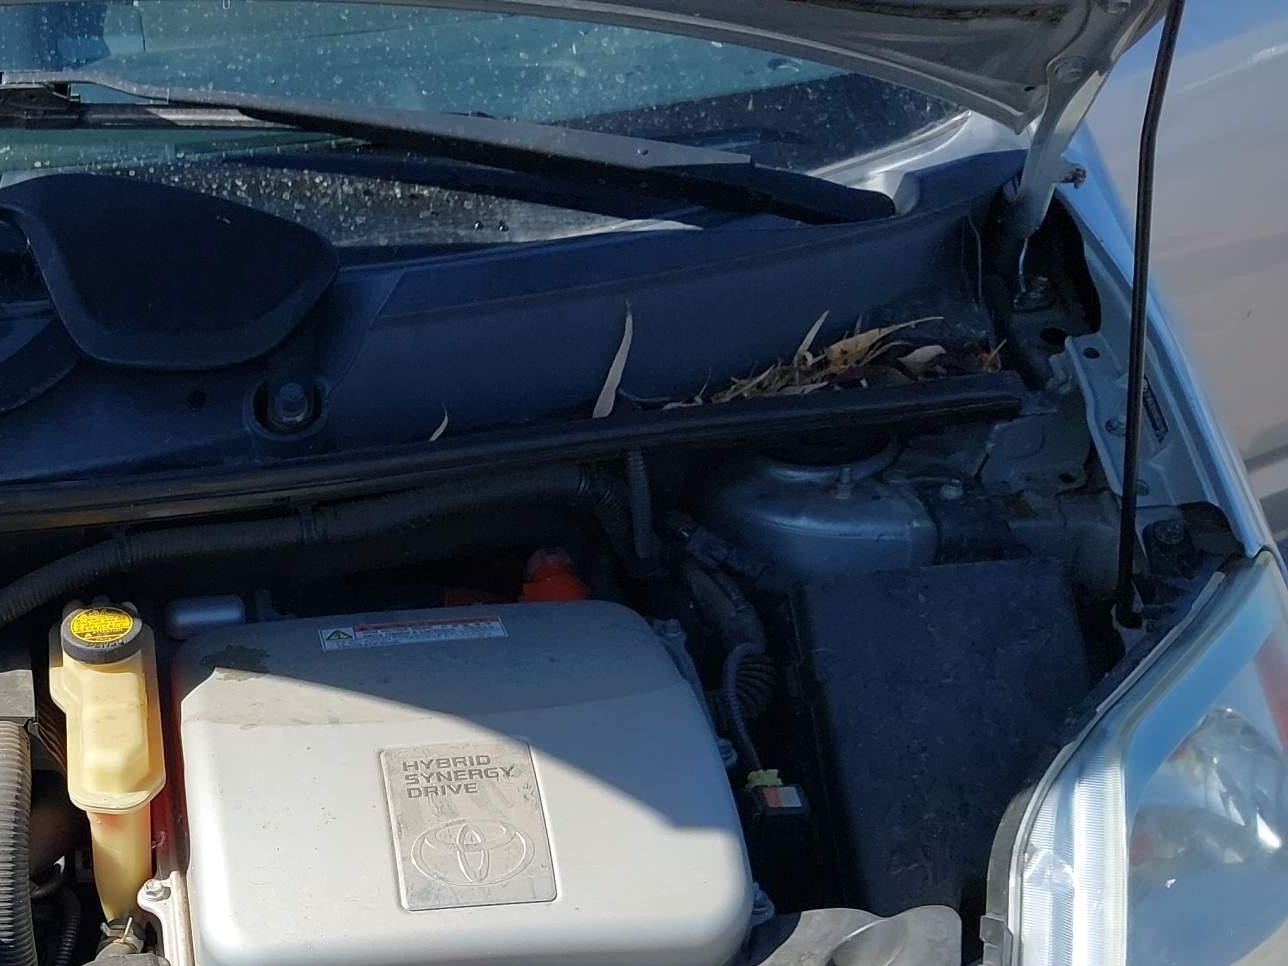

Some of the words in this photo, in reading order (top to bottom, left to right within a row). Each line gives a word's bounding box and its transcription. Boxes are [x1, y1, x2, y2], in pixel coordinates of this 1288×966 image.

[402, 755, 491, 771] HYBRID
[404, 765, 515, 785] SYNERGY
[407, 782, 479, 799] DRIVE
